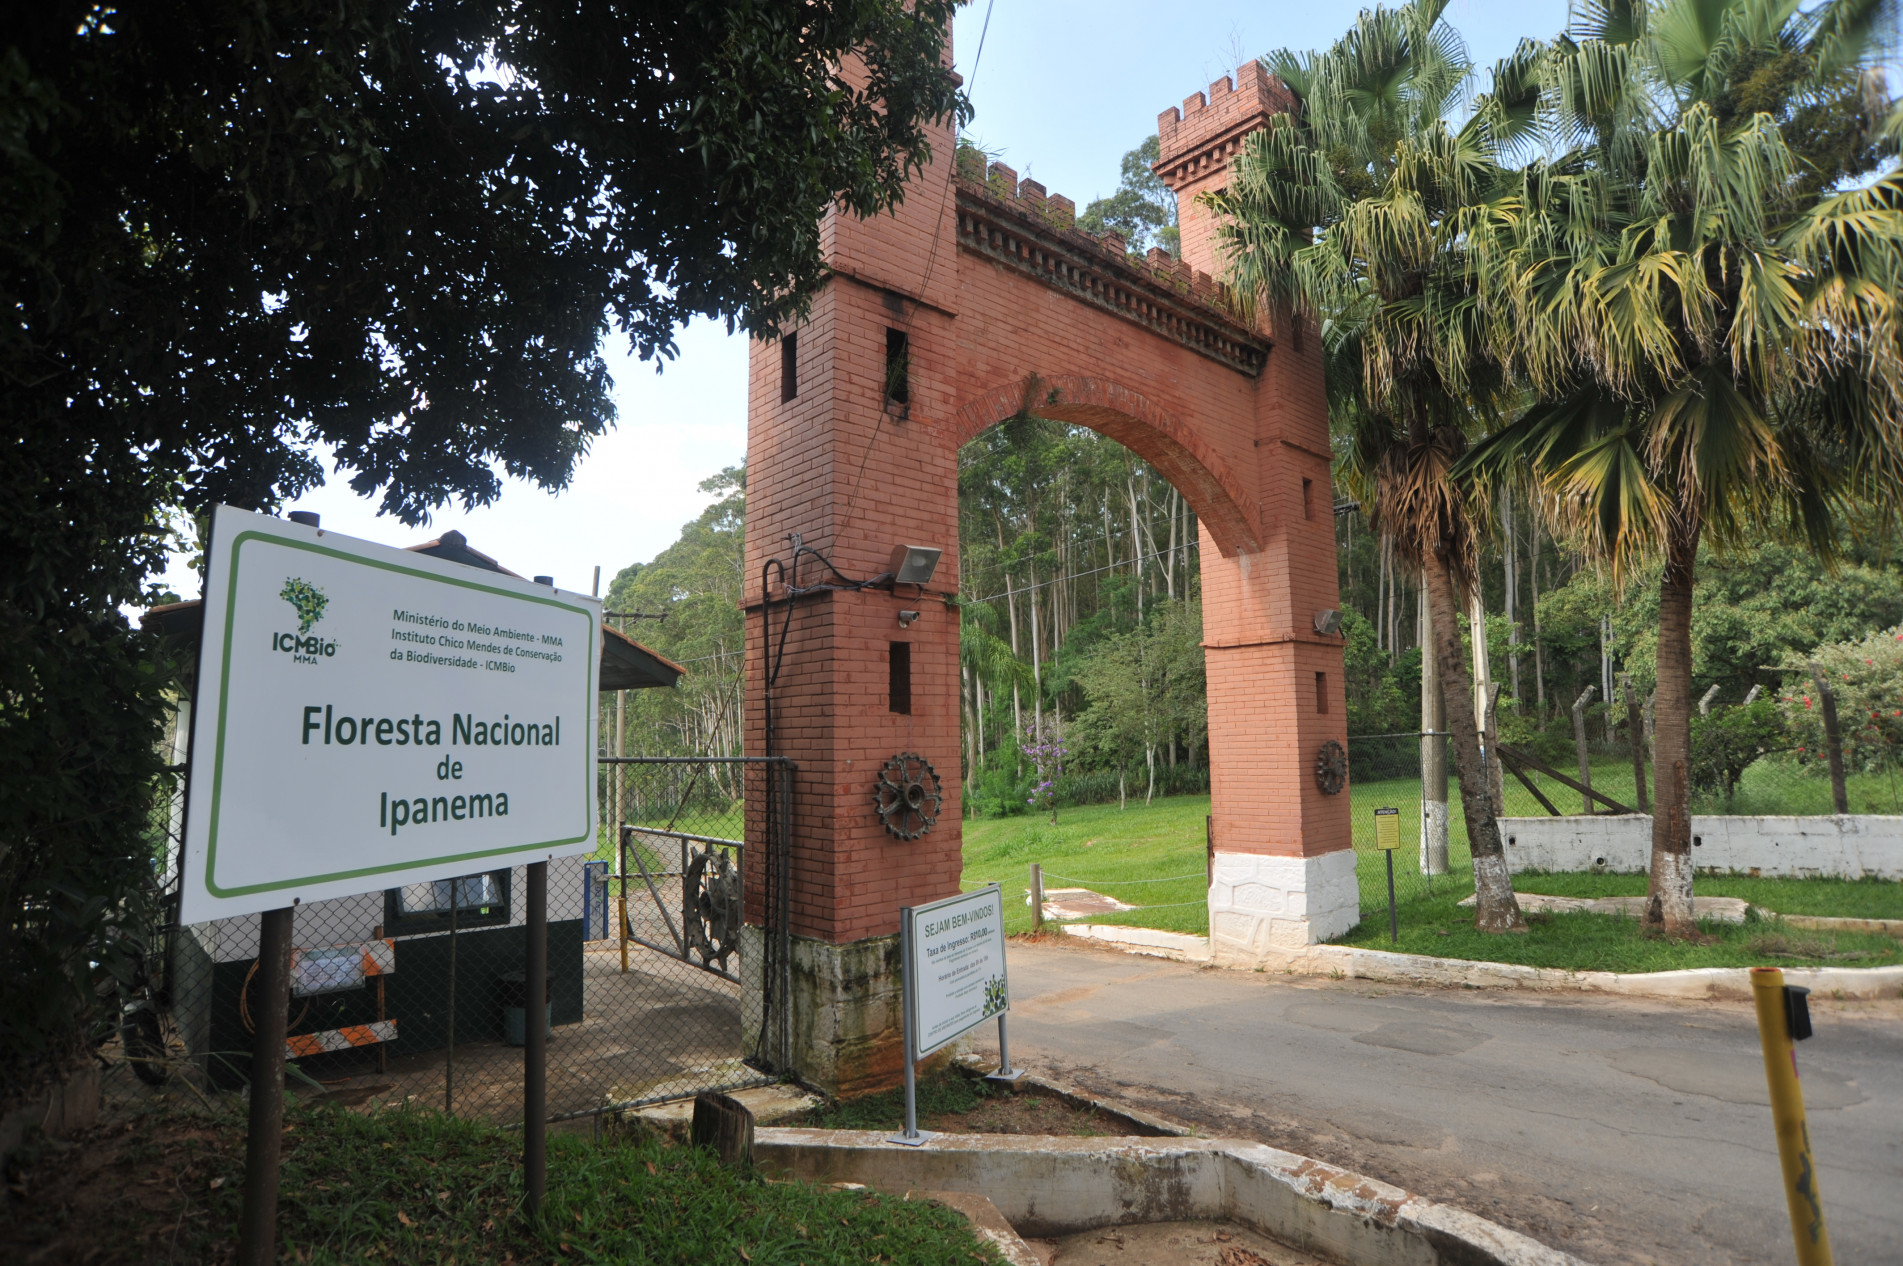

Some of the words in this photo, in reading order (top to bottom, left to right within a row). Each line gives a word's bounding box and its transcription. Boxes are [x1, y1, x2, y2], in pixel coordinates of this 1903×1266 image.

[393, 609, 449, 629] Ministério
[452, 619, 465, 631] do
[467, 622, 491, 636] Meio
[493, 628, 534, 642] Ambiente
[542, 634, 563, 647] MMA
[272, 632, 336, 657] ICMBio
[294, 654, 318, 665] MMA
[392, 628, 436, 645] Instituto
[438, 636, 464, 649] Chico
[466, 640, 501, 654] Mendes
[503, 644, 514, 656] de
[515, 646, 562, 664] Conservação
[390, 648, 404, 660] da
[406, 650, 478, 669] Biodiversidade
[486, 660, 516, 673] ICMBio
[301, 704, 441, 746] Floresta
[452, 712, 561, 746] Nacional
[436, 754, 463, 781] de
[380, 792, 509, 836] Ipanema
[924, 918, 950, 938] SEJAM
[952, 904, 994, 928] BEM-VINDOS!
[926, 947, 939, 958] Taxa
[940, 944, 946, 952] de
[947, 936, 969, 951] Ingresso:
